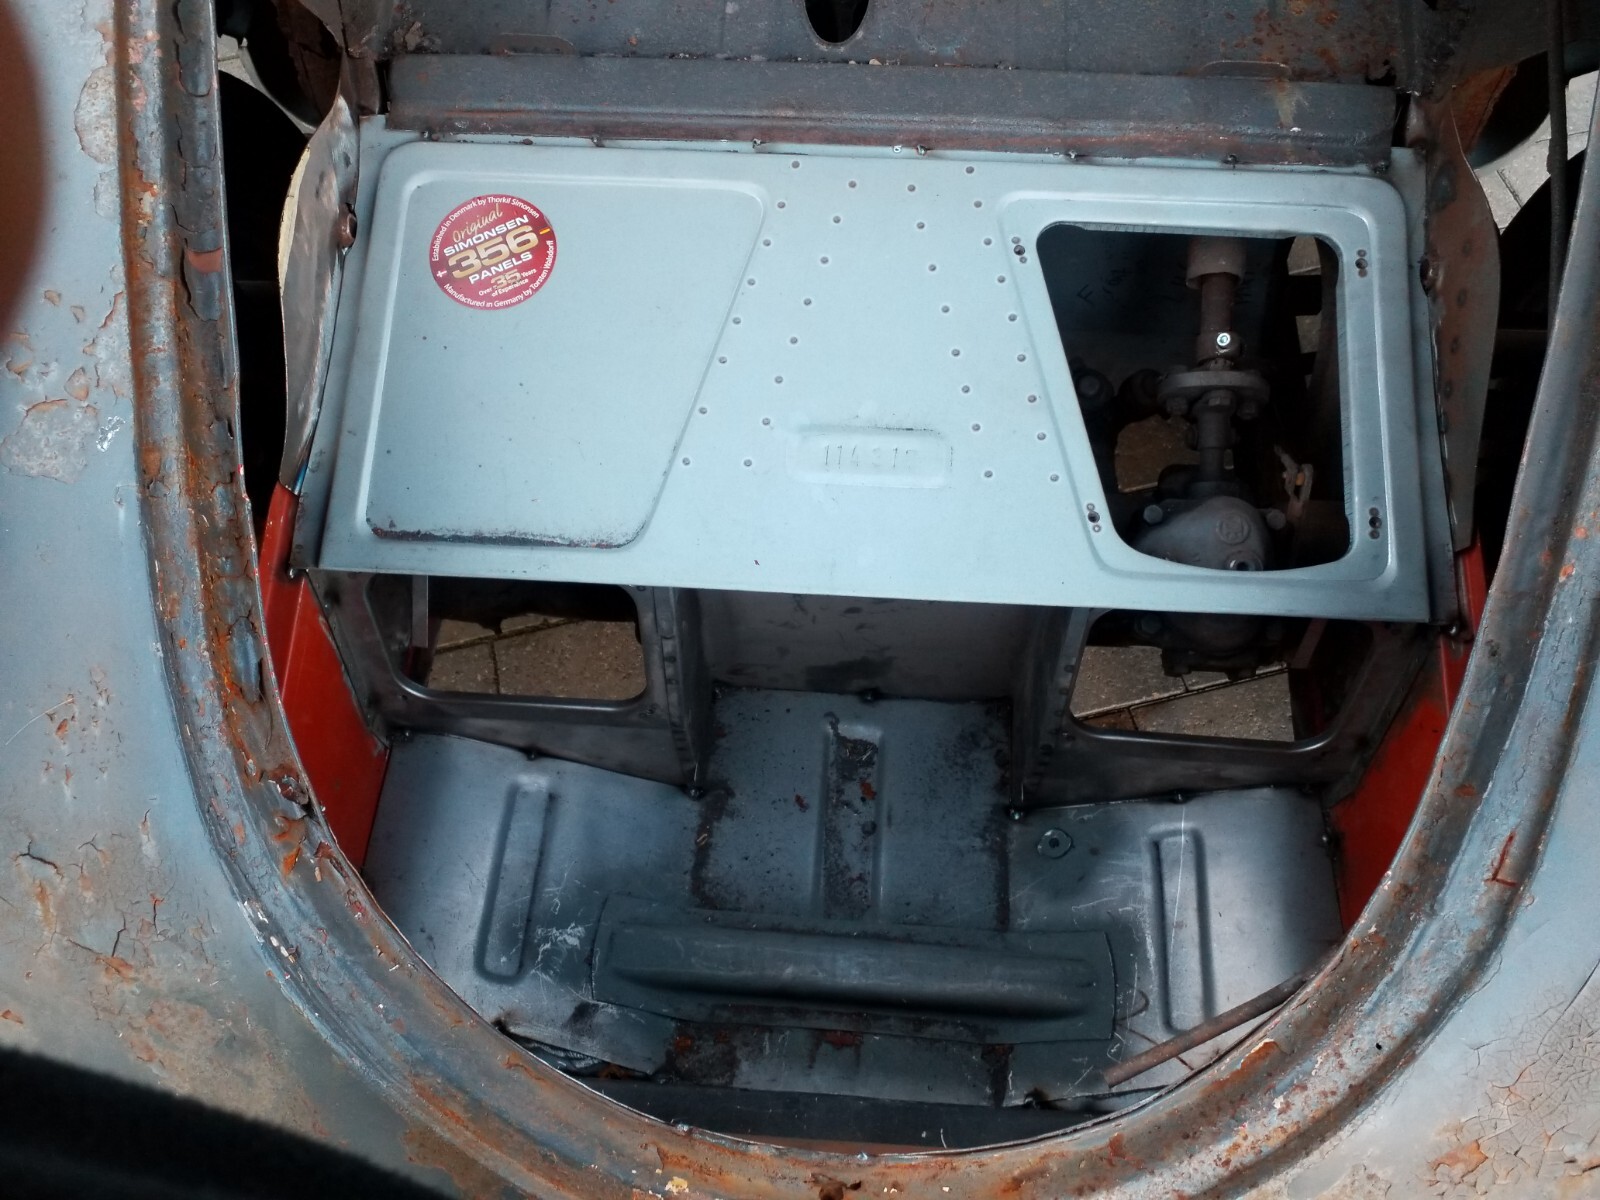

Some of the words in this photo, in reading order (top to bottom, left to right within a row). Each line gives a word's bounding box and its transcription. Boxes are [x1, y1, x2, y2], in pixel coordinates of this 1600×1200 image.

[432, 226, 447, 262] Established
[445, 219, 451, 227] in
[450, 201, 478, 221] Denmark
[477, 197, 486, 206] by
[511, 198, 540, 219] Simonsen
[443, 214, 529, 257] SIMONSEN
[448, 224, 539, 279] 356
[468, 251, 533, 284] PANELS
[444, 283, 486, 307] Manufactured
[493, 293, 524, 307] Germany
[523, 287, 532, 297] by
[530, 269, 548, 290] Torsten
[478, 286, 492, 296] Over
[490, 268, 522, 290] 35
[521, 268, 537, 278] Years
